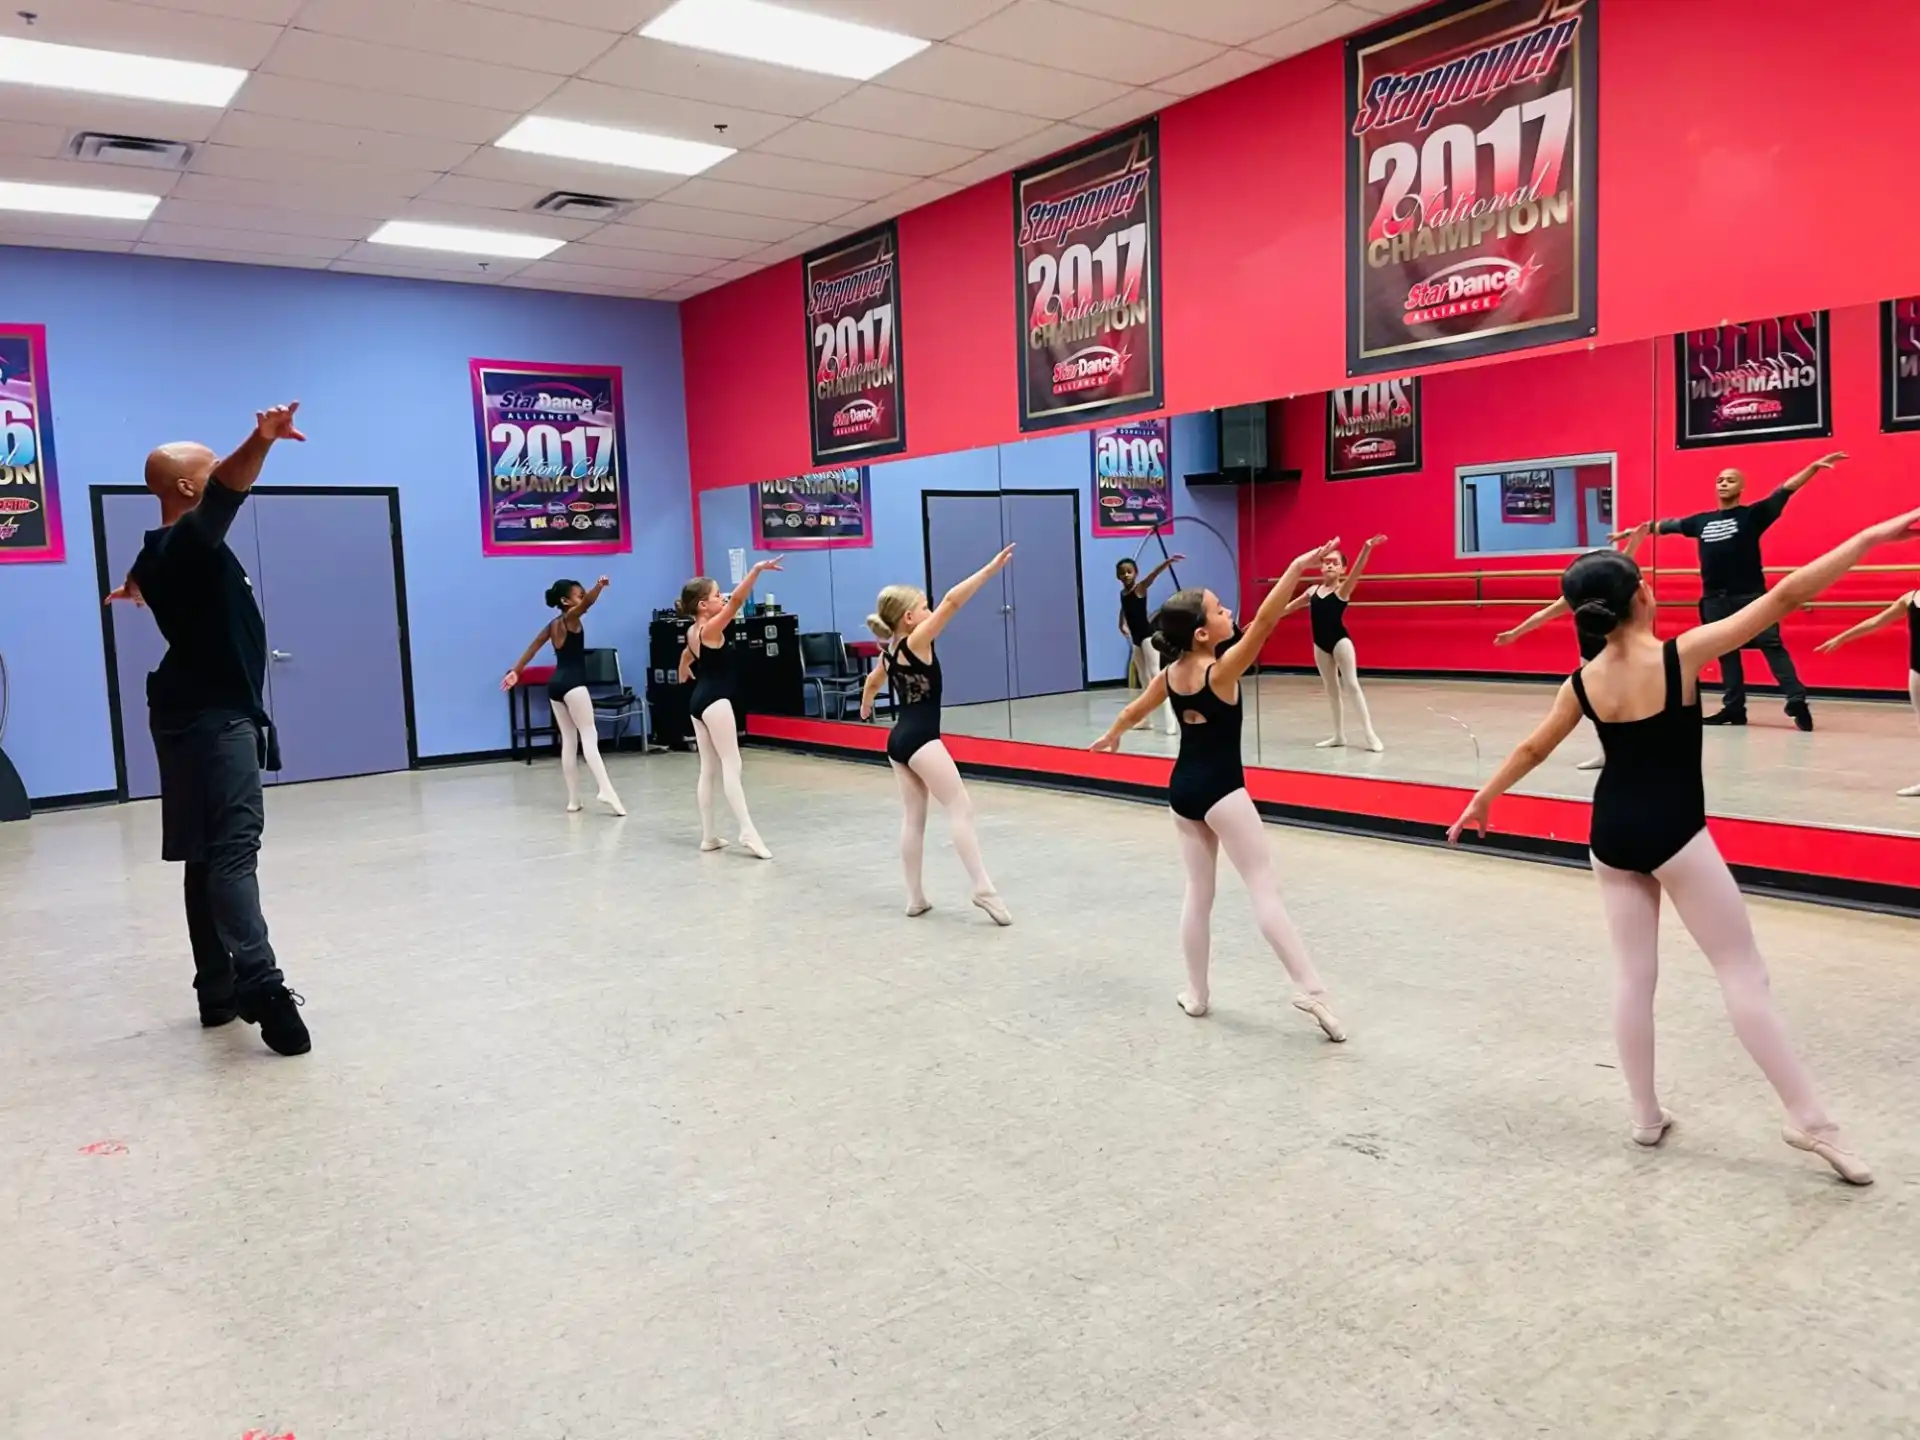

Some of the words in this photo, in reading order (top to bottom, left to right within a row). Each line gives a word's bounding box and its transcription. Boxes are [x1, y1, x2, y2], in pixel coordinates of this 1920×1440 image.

[1353, 14, 1584, 135] Starpower
[1368, 87, 1573, 243] 2017
[1018, 168, 1150, 247] Starpower
[1382, 162, 1551, 239] National
[1368, 191, 1571, 269] CHAMPION
[807, 260, 893, 319] Starpower
[1028, 222, 1146, 327] 2017
[1034, 275, 1134, 327] National
[1030, 299, 1147, 350] CHAMPION
[1412, 298, 1492, 322] ALLIANCE
[815, 303, 892, 383] 2017
[823, 352, 884, 383] National
[500, 390, 593, 412] StarDance
[817, 363, 895, 400] CHAMPION
[507, 412, 573, 421] ALLIANCE
[491, 423, 613, 477] 2017
[500, 456, 568, 484] Victory
[571, 456, 609, 485] Cup
[495, 474, 615, 493] CHAMPION
